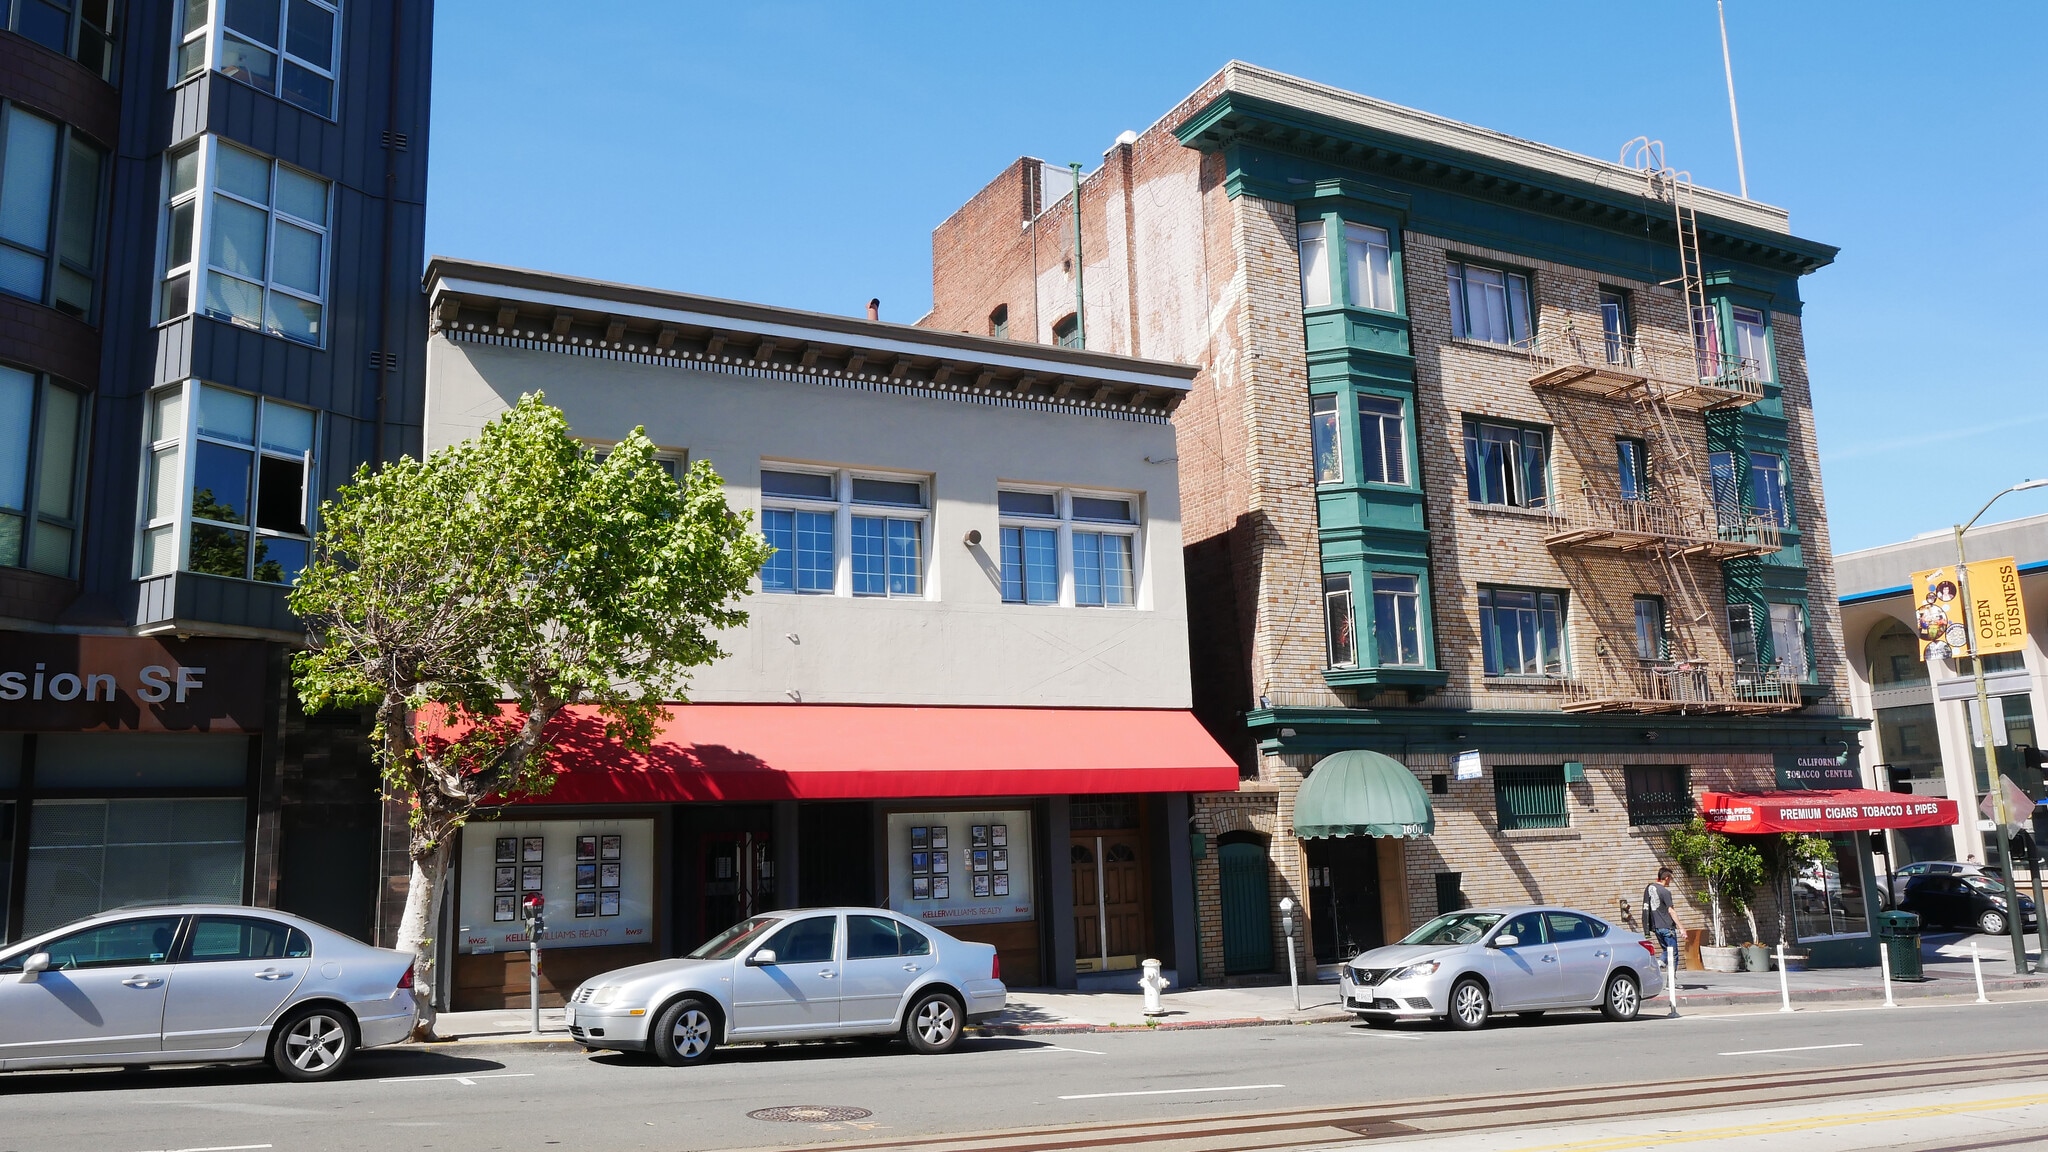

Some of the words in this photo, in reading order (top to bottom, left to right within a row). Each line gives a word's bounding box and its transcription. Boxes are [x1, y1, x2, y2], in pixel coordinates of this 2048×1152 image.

[1999, 565, 2022, 636] BUSINESS
[1977, 599, 1994, 639] OPEN
[1994, 612, 2007, 638] FOR
[0, 662, 117, 702] sion
[136, 665, 207, 703] SF
[1797, 757, 1842, 767] CALIFORNIA
[1785, 769, 1820, 779] TOBACCO
[1824, 769, 1854, 779] CENTER
[1780, 808, 1822, 820] PREMIUM
[1825, 807, 1859, 819] CIGARS
[1862, 805, 1903, 818] TOBACCO
[1906, 805, 1913, 816] &
[1914, 803, 1938, 815] PIPES
[1402, 824, 1423, 834] 1600
[979, 907, 1003, 915] REALTY
[579, 928, 609, 938] REALTY
